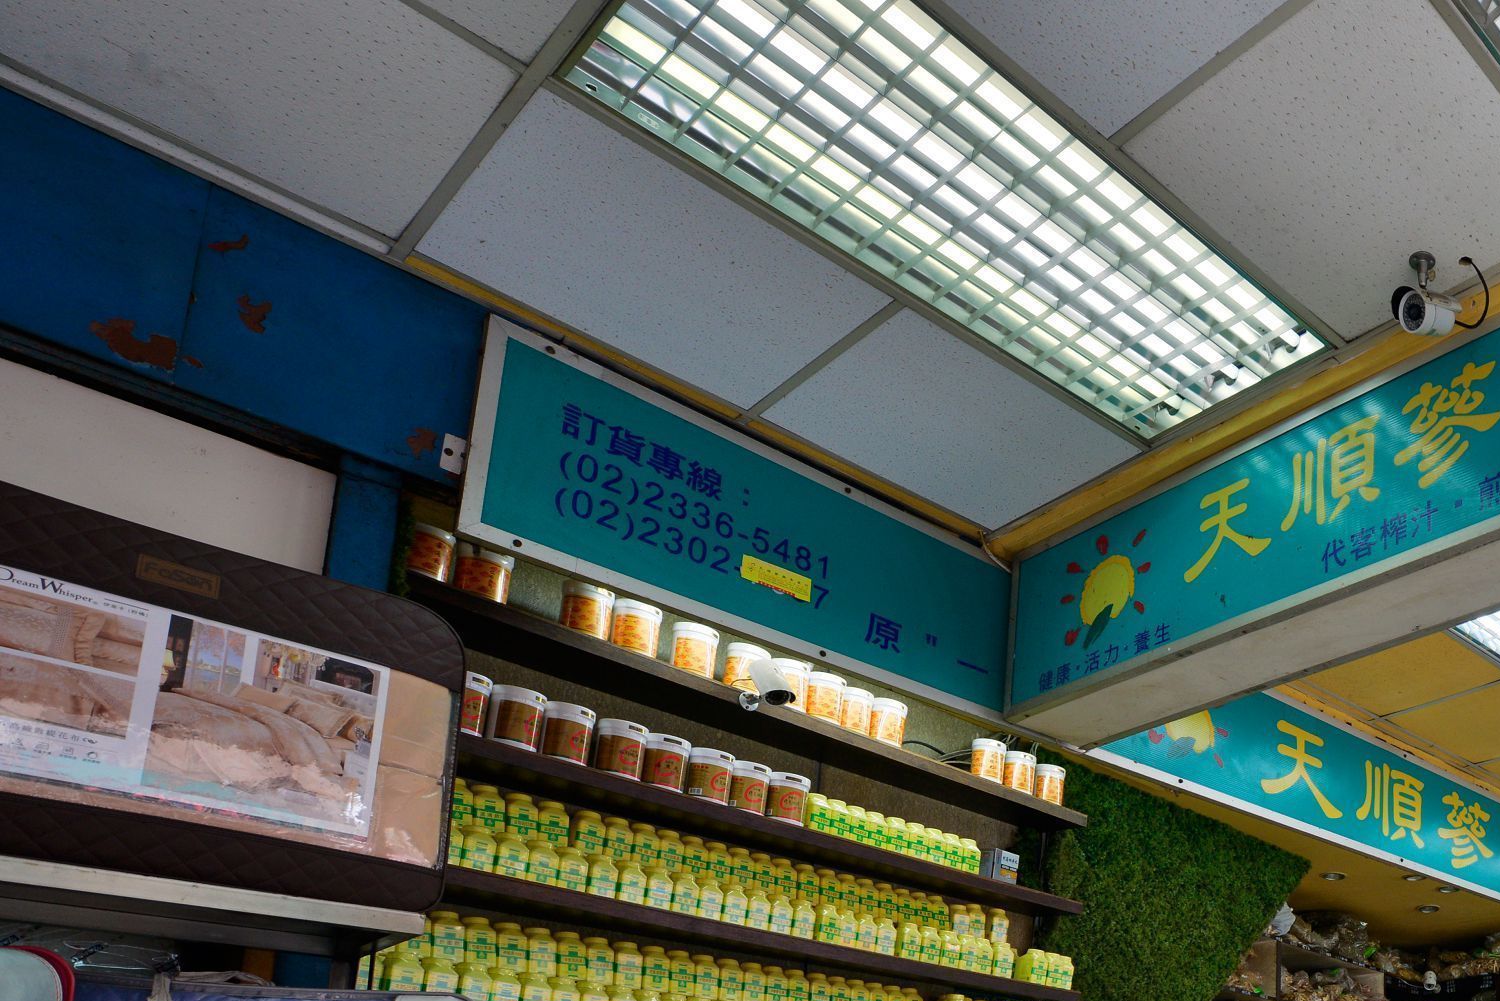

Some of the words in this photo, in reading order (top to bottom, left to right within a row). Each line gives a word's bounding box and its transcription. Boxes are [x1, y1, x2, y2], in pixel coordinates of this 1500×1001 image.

[554, 488, 831, 609] (02)2302-7
[559, 450, 830, 579] (02)2336-5481
[40, 577, 93, 603] Whisper
